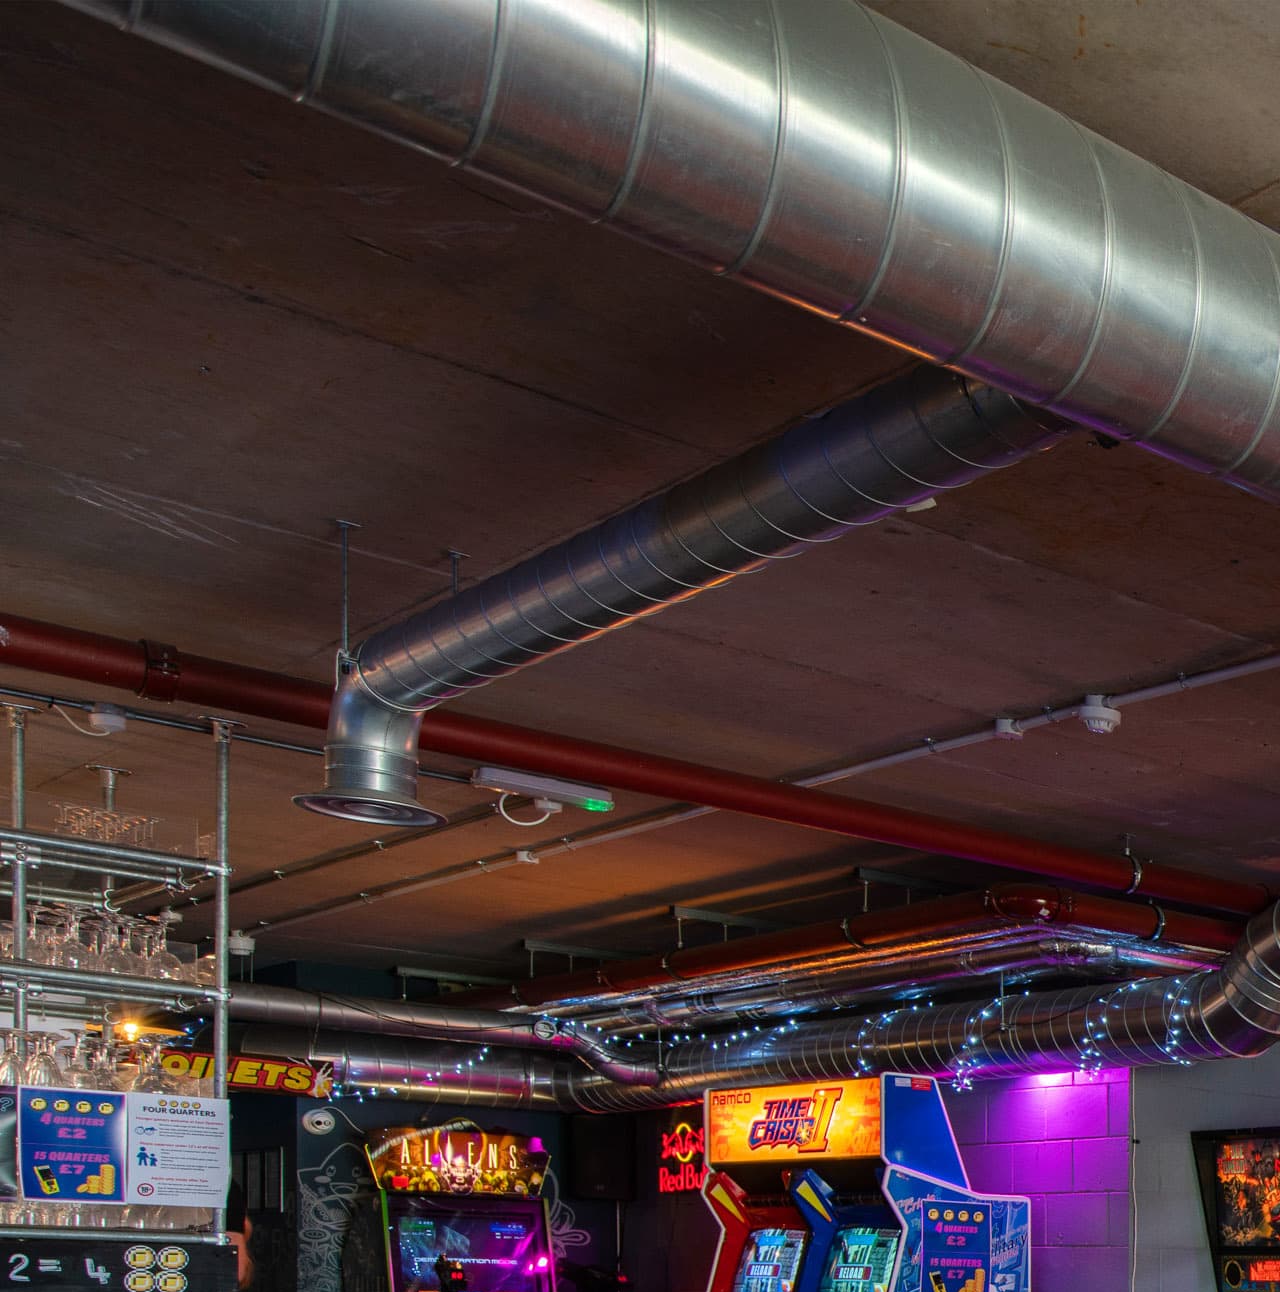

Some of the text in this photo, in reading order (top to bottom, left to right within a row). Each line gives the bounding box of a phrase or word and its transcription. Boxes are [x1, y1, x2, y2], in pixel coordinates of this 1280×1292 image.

[712, 1092, 751, 1106] namco
[143, 1105, 217, 1118] FOUR QUARTERS
[763, 1097, 813, 1120] TIME
[40, 1113, 105, 1127] 4 QUARTERS
[57, 1128, 87, 1139] £2
[34, 1151, 111, 1164] 15 QUARTERS
[400, 1138, 520, 1170] ALIENS
[58, 1164, 86, 1175] £7
[659, 1164, 685, 1193] Red
[935, 1221, 978, 1234] 4 QUARTERS
[946, 1236, 966, 1247] £2
[8, 1253, 31, 1282] 2
[84, 1257, 112, 1285] 4
[940, 1258, 982, 1268] QUARTERS
[838, 1266, 863, 1279] RELOAD
[947, 1269, 965, 1279] £7
